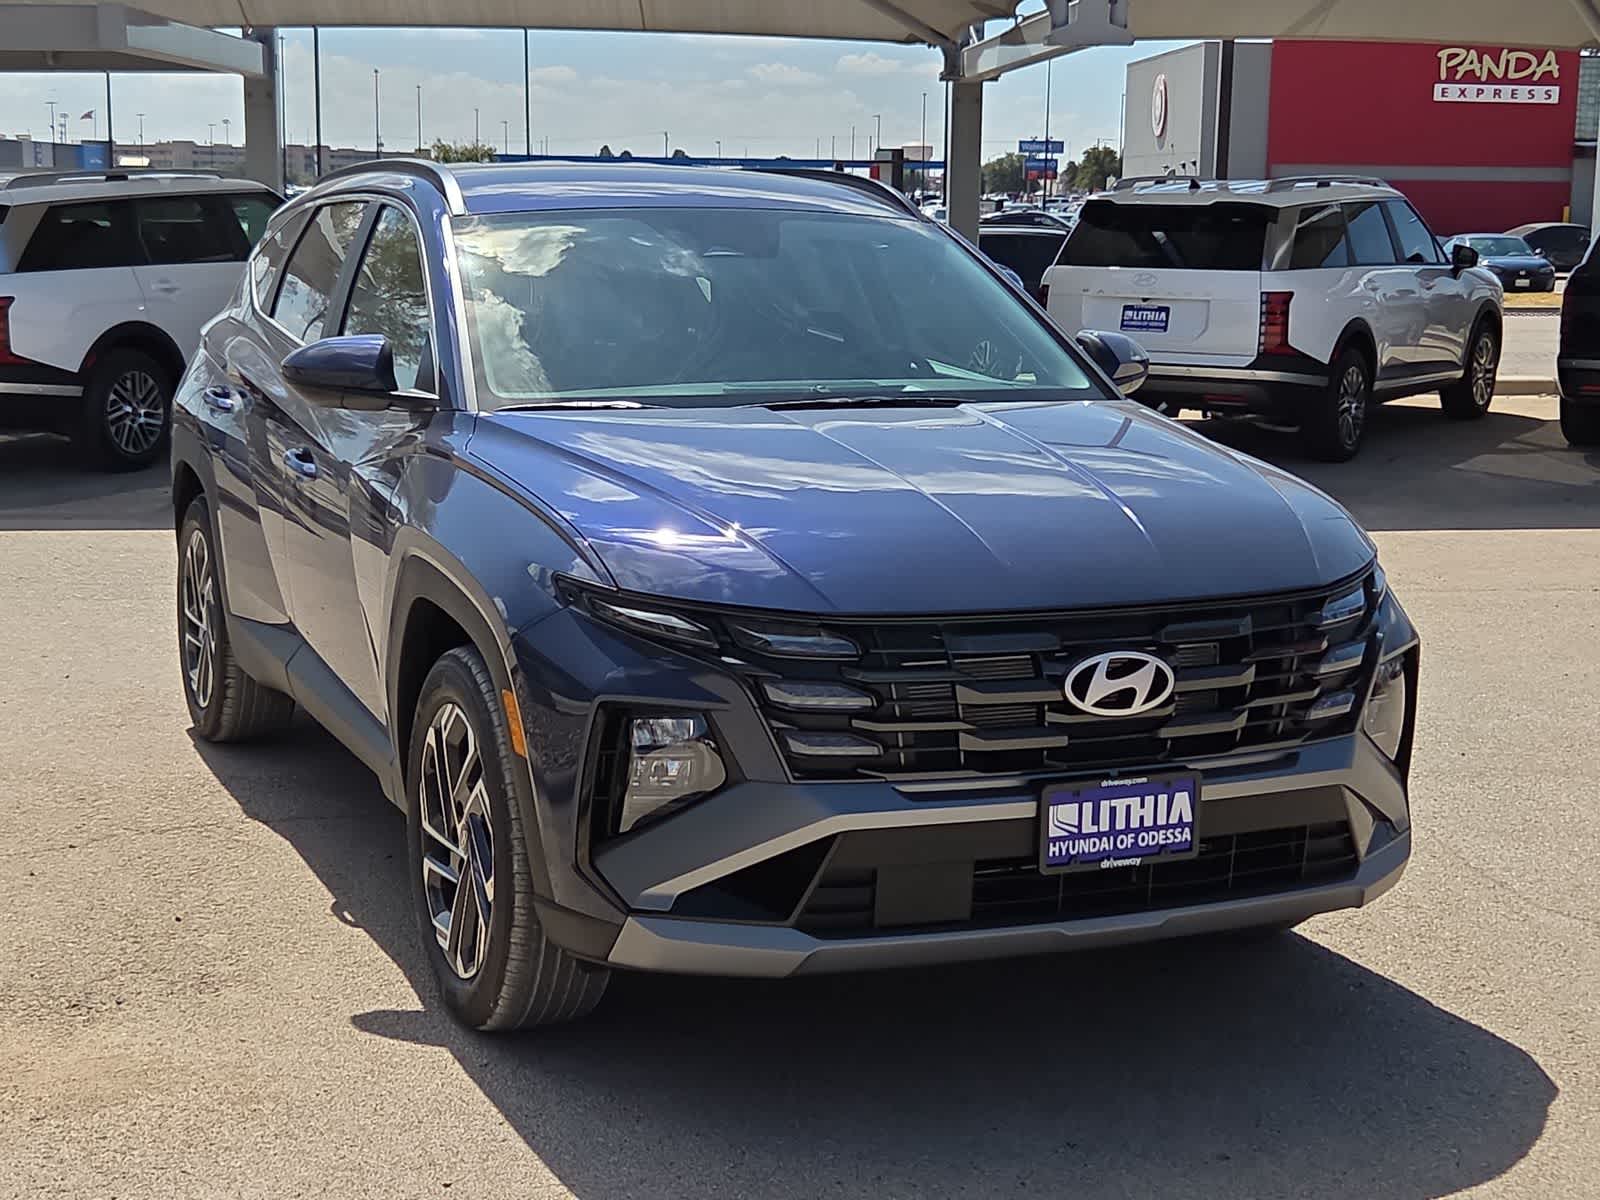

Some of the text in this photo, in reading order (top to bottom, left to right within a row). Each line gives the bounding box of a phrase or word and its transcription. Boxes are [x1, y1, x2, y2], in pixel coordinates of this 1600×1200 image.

[1437, 48, 1560, 81] PANDA
[1441, 87, 1553, 100] EXPRESS
[1133, 311, 1166, 320] LITHIA
[1081, 792, 1193, 833] LITHIA
[1049, 827, 1191, 857] HYUNDAI OF ODESSA
[1101, 857, 1142, 869] driveway
